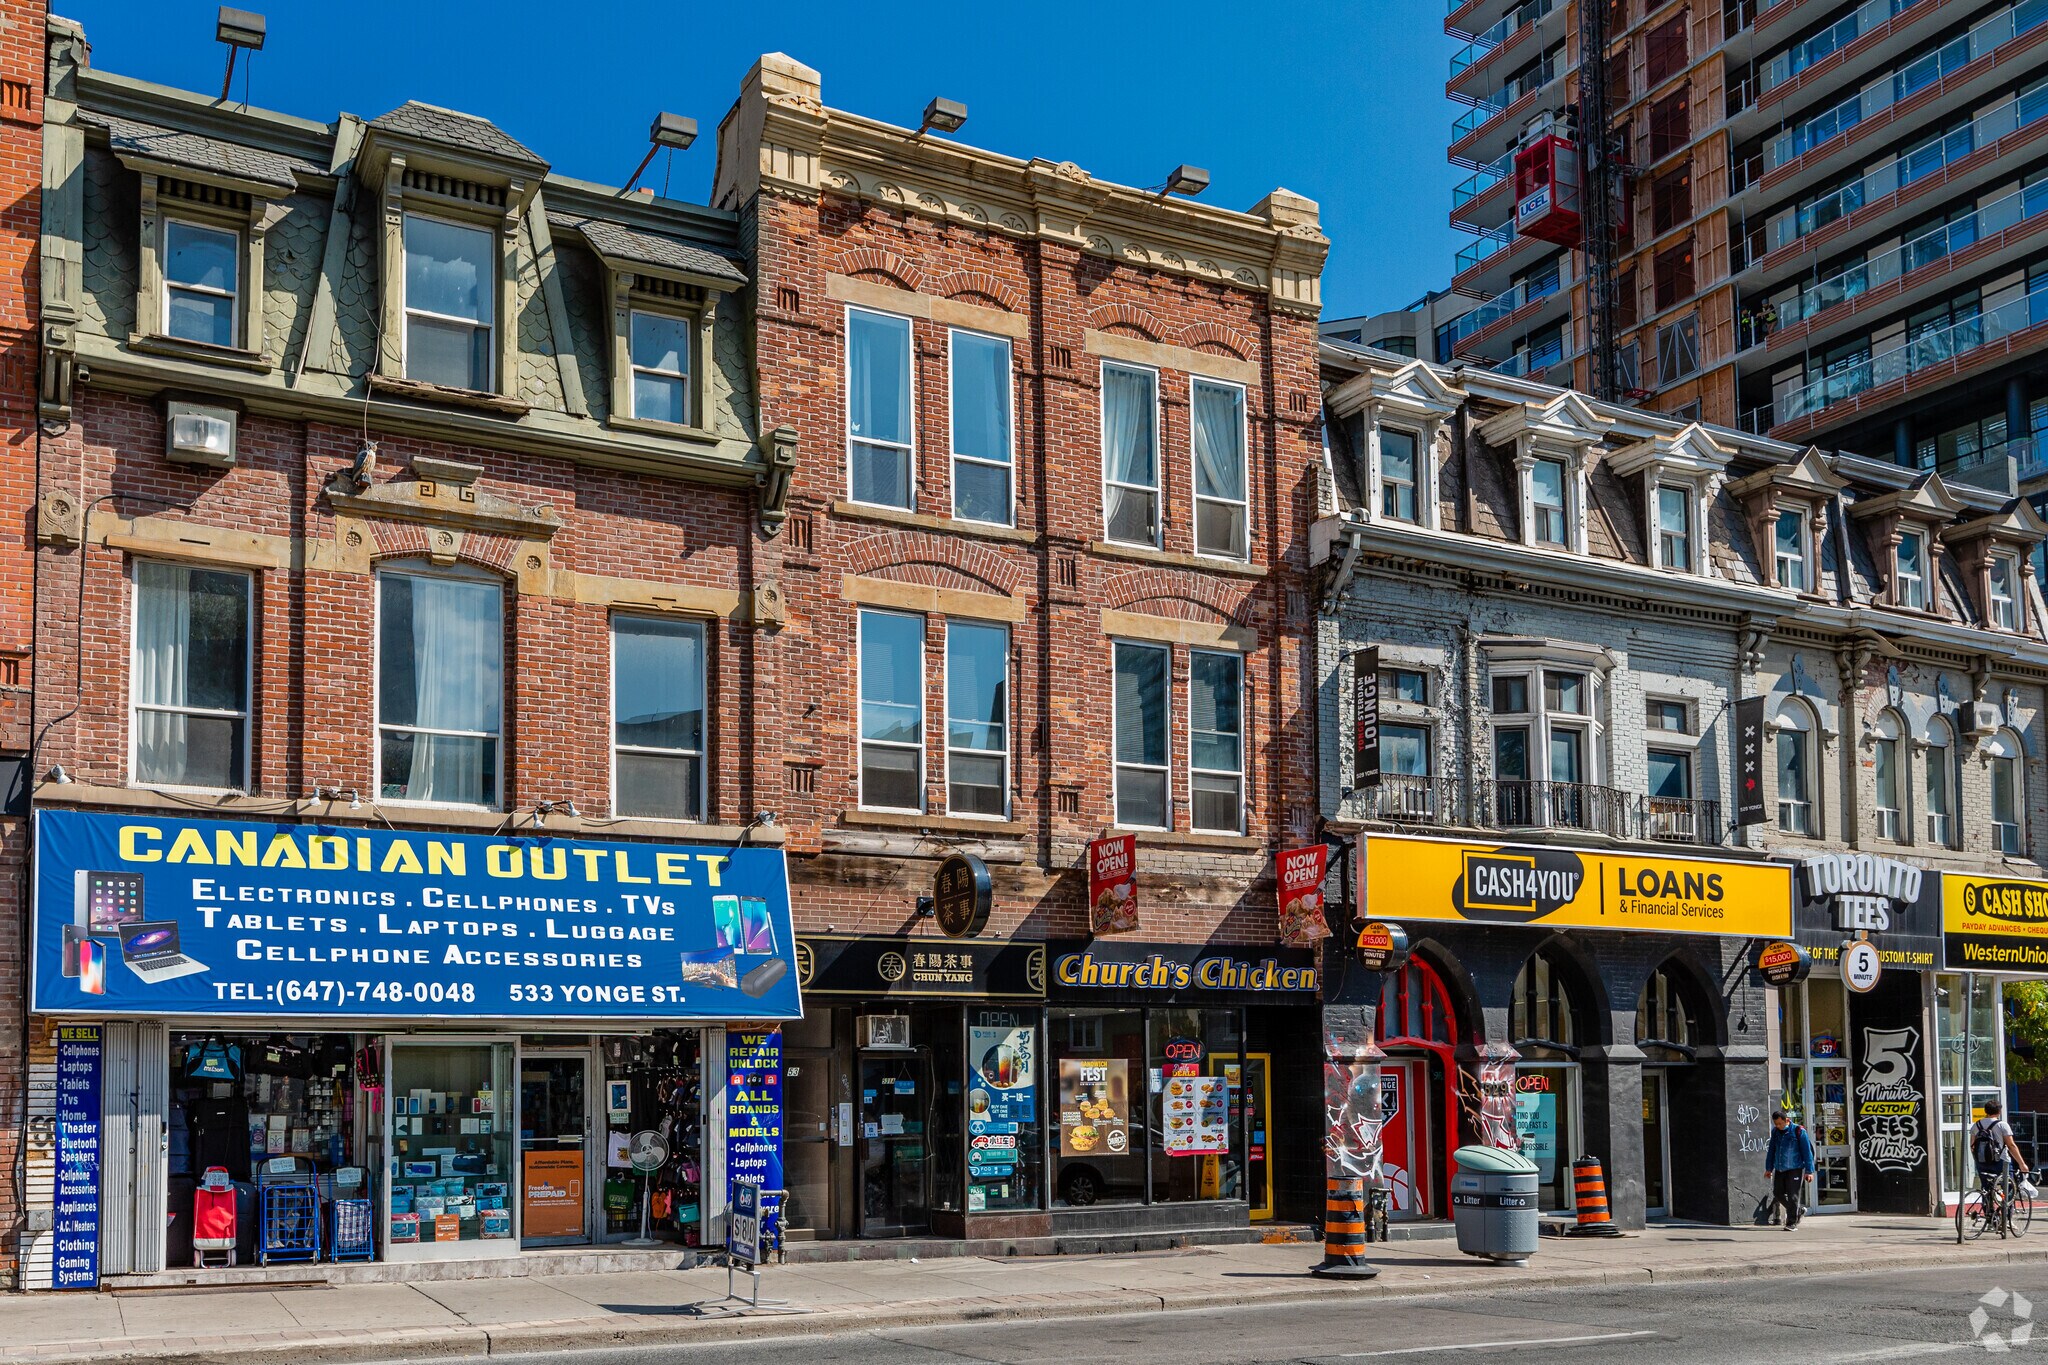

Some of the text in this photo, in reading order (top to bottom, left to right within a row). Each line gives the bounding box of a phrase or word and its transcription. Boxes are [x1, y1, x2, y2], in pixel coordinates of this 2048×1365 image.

[1521, 194, 1548, 216] UCEL
[1364, 672, 1377, 750] LOUNGE
[118, 825, 728, 887] CANADIAN OUTLET
[1098, 840, 1125, 858] NOW
[1096, 853, 1129, 873] OPEN!
[1286, 852, 1318, 871] NOW
[1284, 865, 1319, 884] OPEN!
[1802, 854, 1922, 903] TORONTO
[1618, 867, 1725, 902] LOANS
[192, 878, 396, 907] ELECTRONICS
[422, 887, 598, 914] CELLPHONES
[1619, 899, 1724, 919] & Financial Services
[1835, 895, 1890, 931] TEES
[196, 906, 675, 941] TABLETS LAPTOPS LUGGAGE
[1962, 922, 1987, 931] PAYDAY
[1988, 924, 2021, 933] ADVANCES
[1363, 936, 1387, 945] $15,000
[236, 939, 643, 968] CELLPHONE ACCESSORIES
[1765, 952, 1791, 963] $15,000
[1813, 947, 1823, 959] OF
[1824, 948, 1839, 960] THE
[1906, 953, 1933, 964] T-SHIRT
[913, 953, 973, 969] 春陽茶事
[1858, 952, 1869, 972] 5
[1056, 953, 1318, 990] Church's Chicken
[1768, 966, 1791, 974] MINUTES
[1853, 973, 1873, 981] MINUTE
[913, 973, 973, 983] CHUN YANG
[509, 984, 686, 1003] 533 YONGE ST.
[61, 1028, 99, 1039] WE SELL
[741, 1035, 767, 1044] WE
[63, 1044, 99, 1058] Cellphones
[729, 1047, 779, 1056] REPAIR
[1166, 1044, 1201, 1059] OPEN
[1821, 1044, 1833, 1054] 527
[1863, 1026, 1920, 1085] 5
[62, 1060, 92, 1074] Laptops
[729, 1059, 778, 1068] UNLOCK
[1080, 1067, 1107, 1081] FEST
[62, 1078, 90, 1090] Tablets
[1484, 1081, 1508, 1097] 529
[1518, 1076, 1549, 1091] OPEN
[735, 1090, 773, 1101] ALL
[1857, 1080, 1924, 1104] Minute
[62, 1094, 78, 1105] Tvs
[62, 1110, 87, 1120] Home
[729, 1105, 779, 1114] BRANDS
[1864, 1104, 1911, 1113] CUSTOM
[62, 1122, 96, 1133] Theater
[750, 1117, 758, 1126] &
[1858, 1116, 1919, 1139] TEES
[729, 1128, 779, 1137] MODELS
[61, 1137, 97, 1149] Bluetooth
[735, 1143, 777, 1155] Cellphones
[1869, 1137, 1921, 1159] Masks
[61, 1151, 95, 1163] Speakers
[735, 1158, 767, 1170] Laptops
[60, 1169, 90, 1183] Cellphone
[60, 1183, 97, 1195] Accessories
[1463, 1195, 1480, 1205] Litter
[1500, 1197, 1518, 1206] Litter
[60, 1201, 96, 1215] Appliances
[59, 1239, 95, 1253] Clothing
[59, 1257, 90, 1270] Gaming
[58, 1271, 94, 1285] Systems
